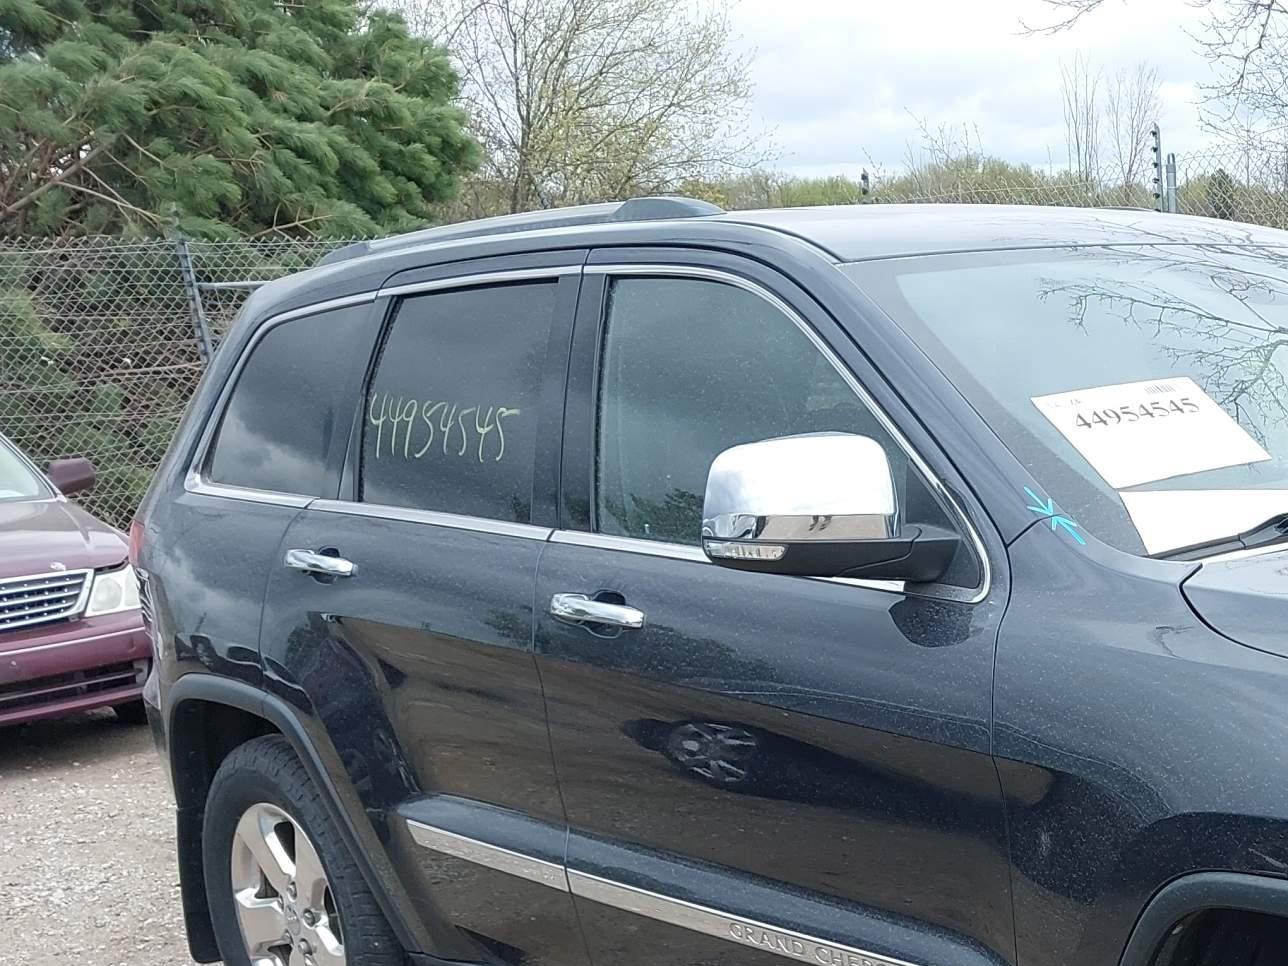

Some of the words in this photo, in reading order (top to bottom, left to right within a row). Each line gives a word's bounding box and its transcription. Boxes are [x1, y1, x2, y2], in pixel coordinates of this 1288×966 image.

[369, 392, 521, 463] 44954545
[1075, 397, 1200, 429] 44954545
[728, 921, 805, 957] GRAND
